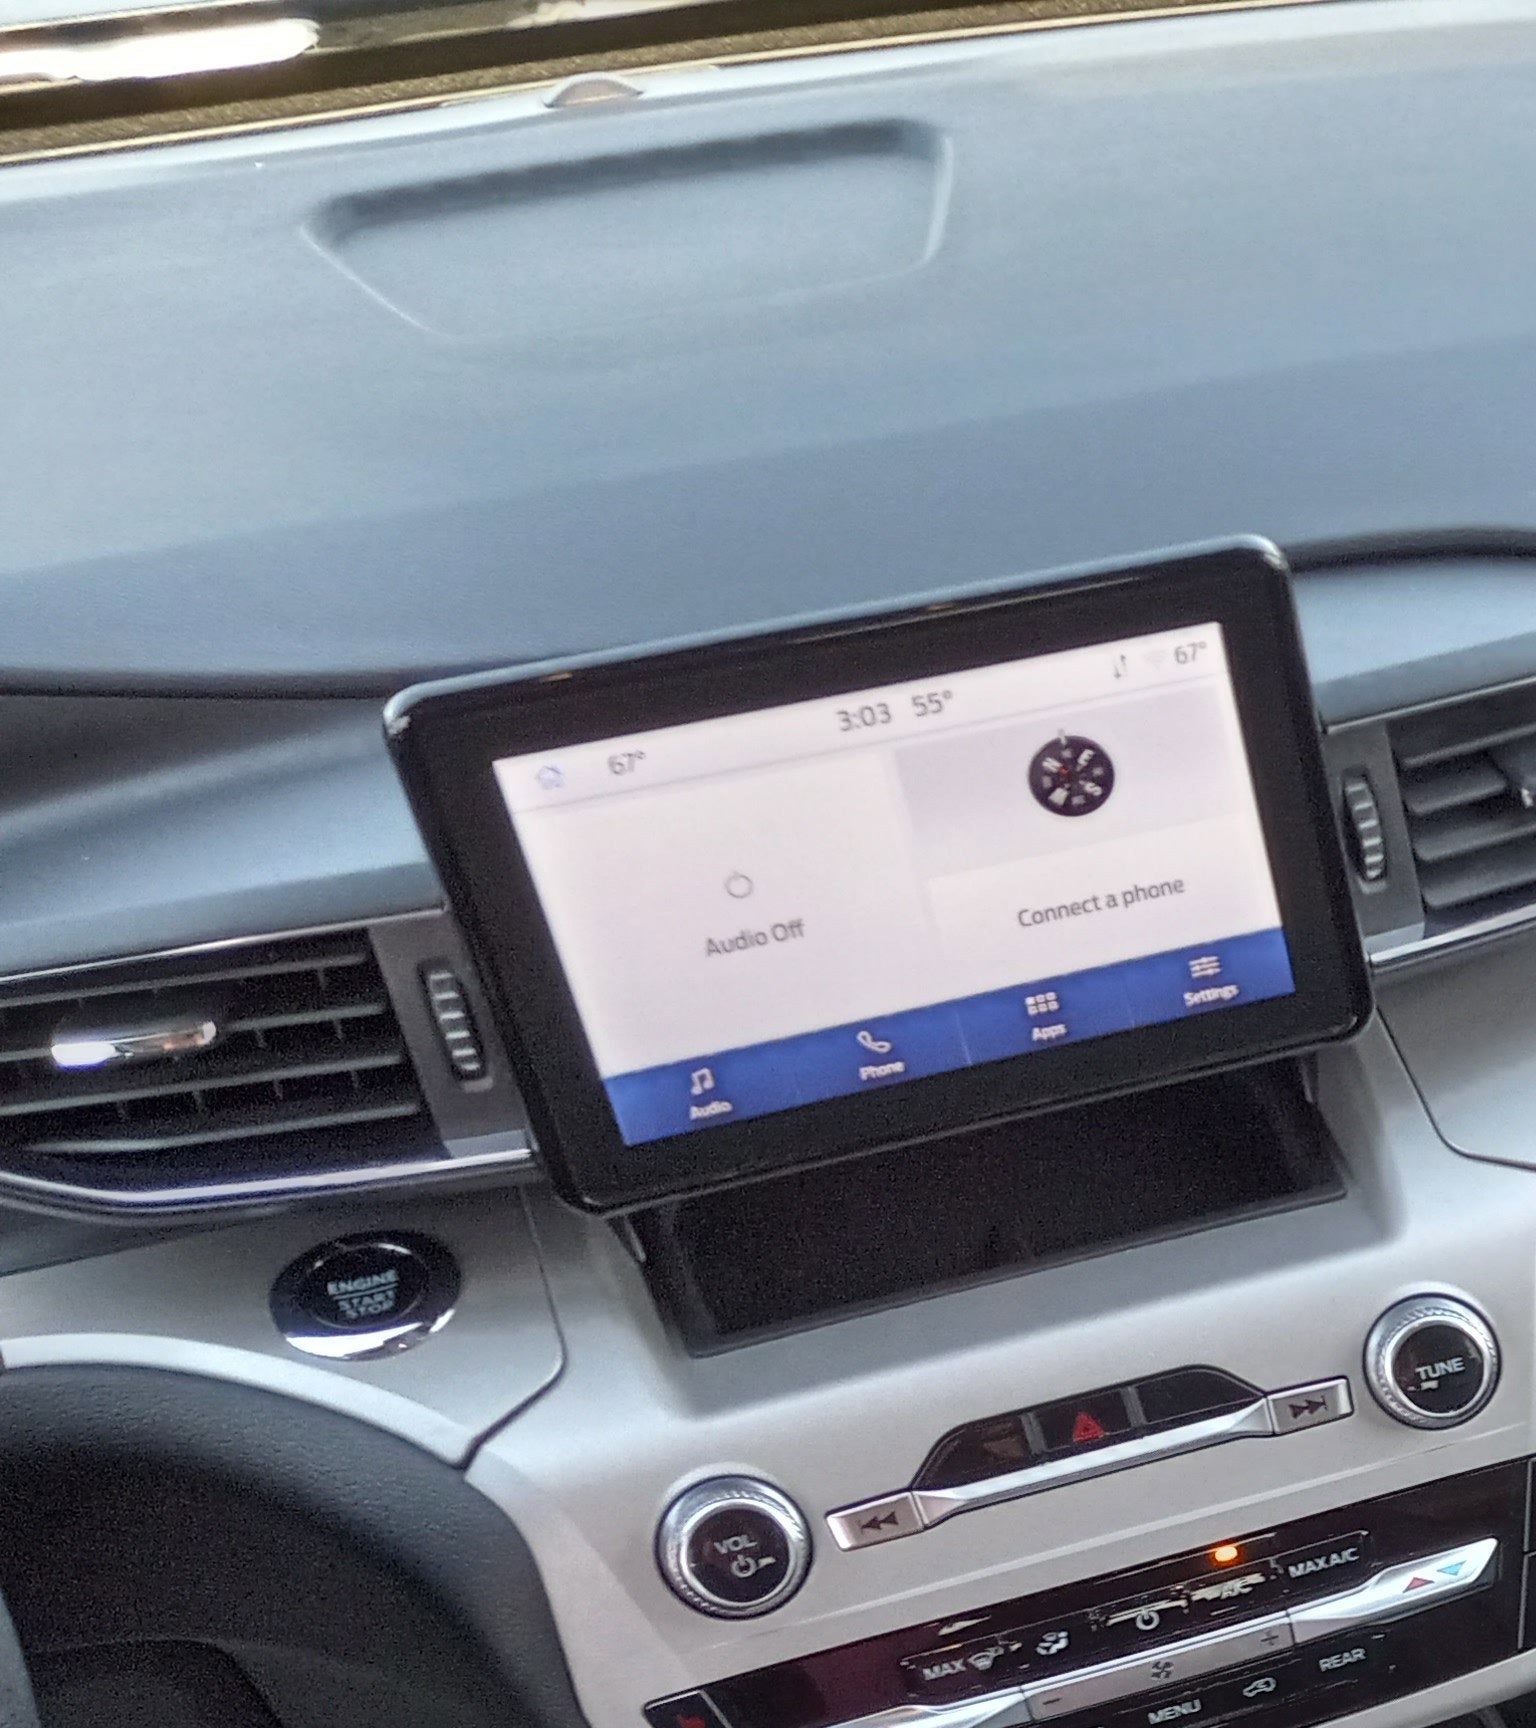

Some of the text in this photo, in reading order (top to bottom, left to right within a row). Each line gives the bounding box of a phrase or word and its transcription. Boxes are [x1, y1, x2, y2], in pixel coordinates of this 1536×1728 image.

[834, 702, 892, 733] 3:03
[1017, 875, 1185, 928] Connect a phone
[703, 918, 805, 958] Audio Off
[1182, 983, 1240, 1008] Settings
[1031, 1020, 1067, 1043] Apps
[858, 1058, 905, 1082] Phone
[688, 1097, 733, 1122] Audio
[327, 1269, 398, 1296] ENGINE
[338, 1290, 396, 1312] START
[1415, 1356, 1466, 1380] TUNE
[713, 1534, 758, 1555] VOL
[1289, 1555, 1327, 1578] MAX
[923, 1659, 966, 1681] MAX
[1319, 1648, 1367, 1672] REAR
[1148, 1700, 1202, 1724] MENU
